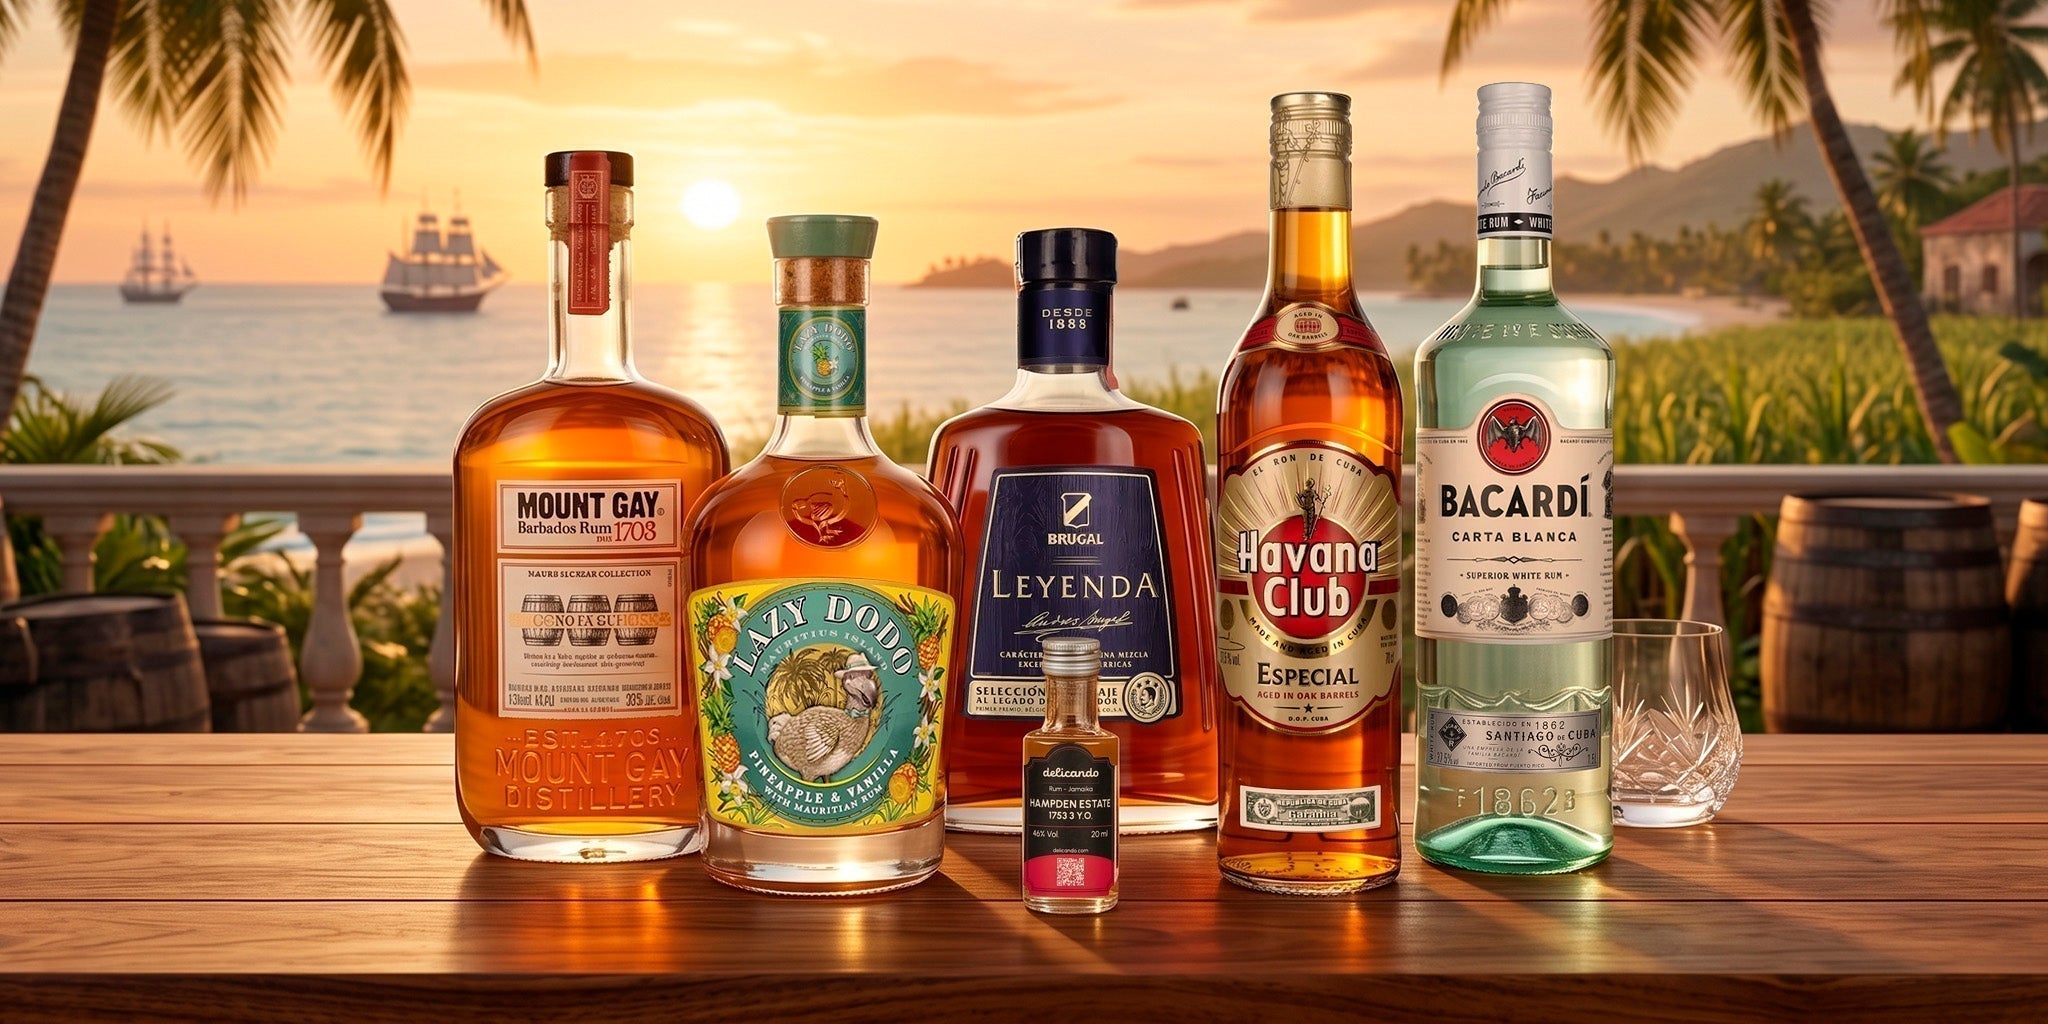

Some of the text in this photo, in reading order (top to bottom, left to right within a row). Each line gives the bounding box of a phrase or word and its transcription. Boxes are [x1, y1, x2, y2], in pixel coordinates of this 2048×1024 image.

[1489, 217, 1509, 228] RUM
[1529, 217, 1552, 229] WHITE
[1042, 308, 1093, 318] DESDE
[1294, 311, 1313, 319] AGED
[1049, 318, 1087, 330] 1888
[794, 324, 819, 352] LAZY
[824, 323, 856, 353] DODO
[1288, 332, 1328, 340] OAK BARRELS
[1253, 453, 1362, 477] EL RON DE CUBA
[1441, 473, 1590, 518] BACARDÍ
[517, 490, 660, 519] MOUNT GAY
[518, 521, 577, 534] Barbados
[580, 521, 612, 534] Rum
[1047, 533, 1104, 546] BRUGAL
[1452, 531, 1577, 542] CARTA BLANCA
[1237, 530, 1381, 574] Havana
[1466, 571, 1562, 580] SUPERIOR WHITE RUM
[992, 569, 1160, 599] LEYENDA
[1262, 576, 1351, 618] Club
[731, 594, 914, 677] LAZY DODO
[1249, 616, 1368, 657] MADE AND AGED IN CUBA
[760, 629, 888, 674] MAURITIUS ISLAND
[1000, 650, 1043, 659] CARÁCTER
[1118, 651, 1149, 659] MEZCLA
[976, 685, 1045, 697] SELECCIÓN
[1257, 690, 1360, 699] AGED IN OAK BARRELS
[993, 697, 1035, 705] LEGADO
[1462, 719, 1518, 727] ESTABLECIDO
[1535, 720, 1565, 730] 1862
[1486, 730, 1554, 742] SANTIAGO
[1567, 729, 1596, 741] CUBA
[496, 748, 690, 784] MOUNT GAY
[1042, 767, 1100, 778] delicando
[748, 748, 899, 804] PINEAPPLE & VANILLA
[1049, 785, 1062, 793] Rum
[1068, 785, 1094, 793] Jamaika
[505, 783, 682, 811] DISTILLERY
[763, 784, 884, 815] WITH MAURITIAN RUM
[1029, 798, 1111, 809] HAMPDEN ESTATE
[1473, 786, 1559, 817] 1862
[1048, 811, 1093, 820] 1753 3 Y.O.
[1032, 829, 1108, 838] 46% Vol. 20 ml
